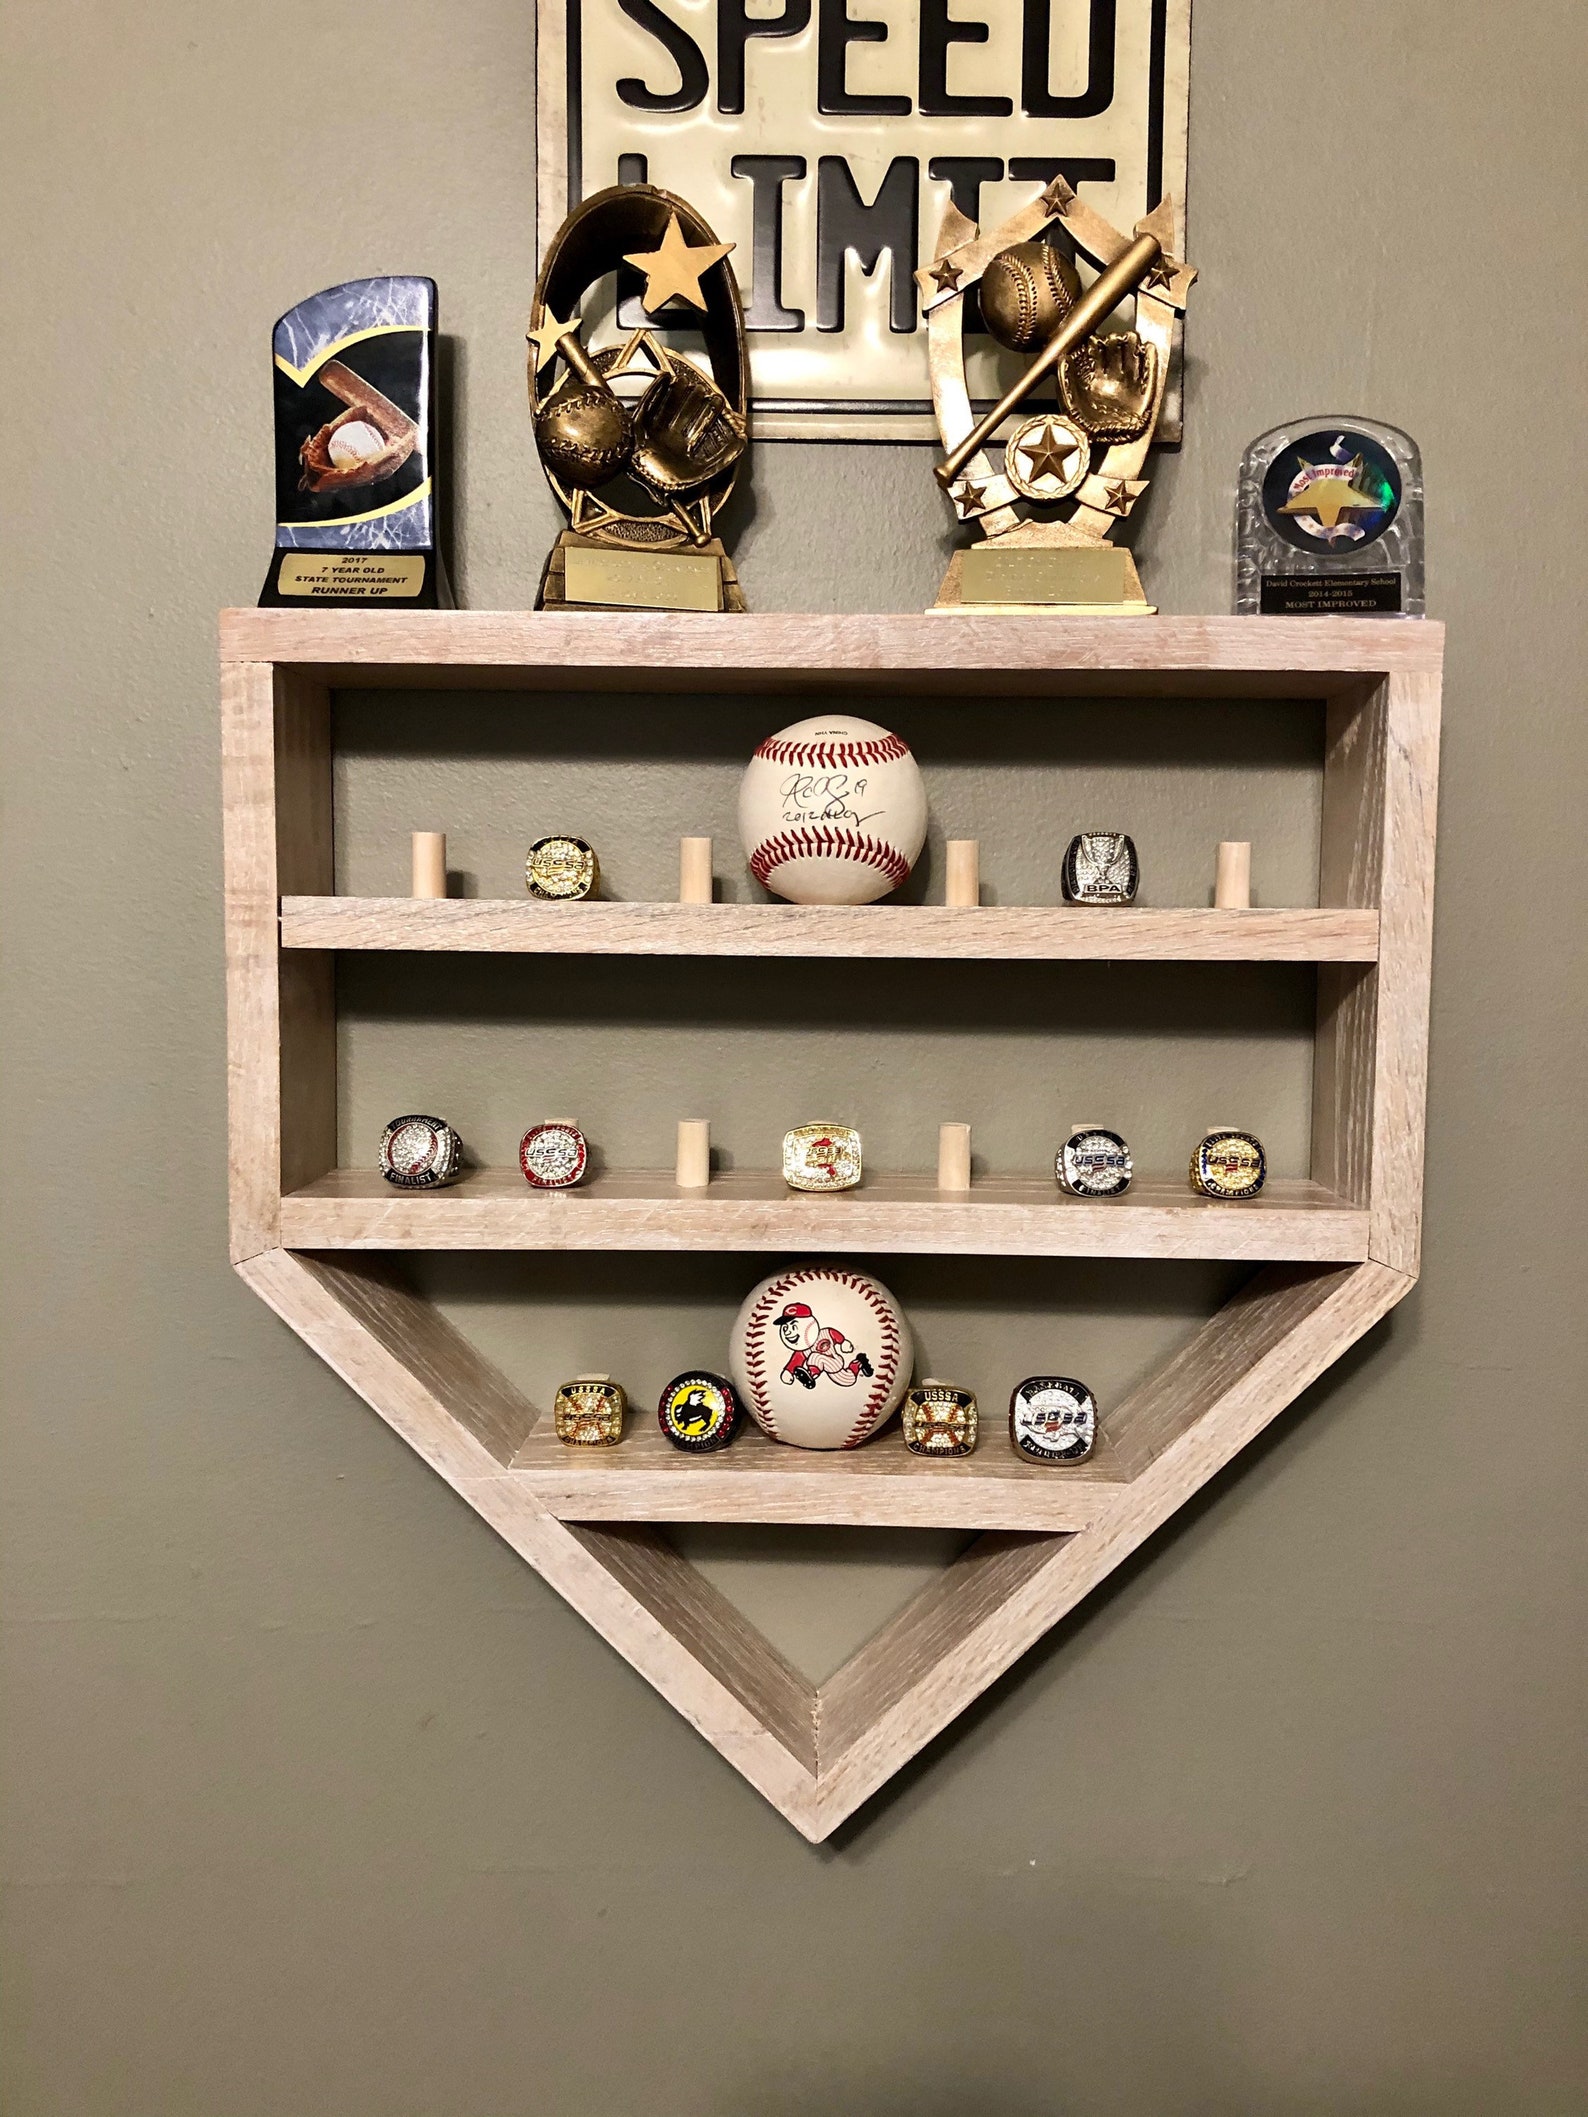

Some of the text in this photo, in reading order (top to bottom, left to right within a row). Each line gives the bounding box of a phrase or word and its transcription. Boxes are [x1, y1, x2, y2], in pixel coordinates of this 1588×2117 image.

[616, 0, 1116, 118] SPEED
[1266, 579, 1287, 587] David
[1324, 578, 1369, 588] Elementary
[1370, 578, 1397, 586] School
[311, 586, 389, 595] RUNNER UP
[1285, 600, 1377, 609] MOST IMPROVED
[1087, 884, 1120, 892] BPA
[389, 1171, 432, 1185] FINALIST
[570, 1386, 606, 1395] USSSA
[924, 1390, 959, 1402] USSSA
